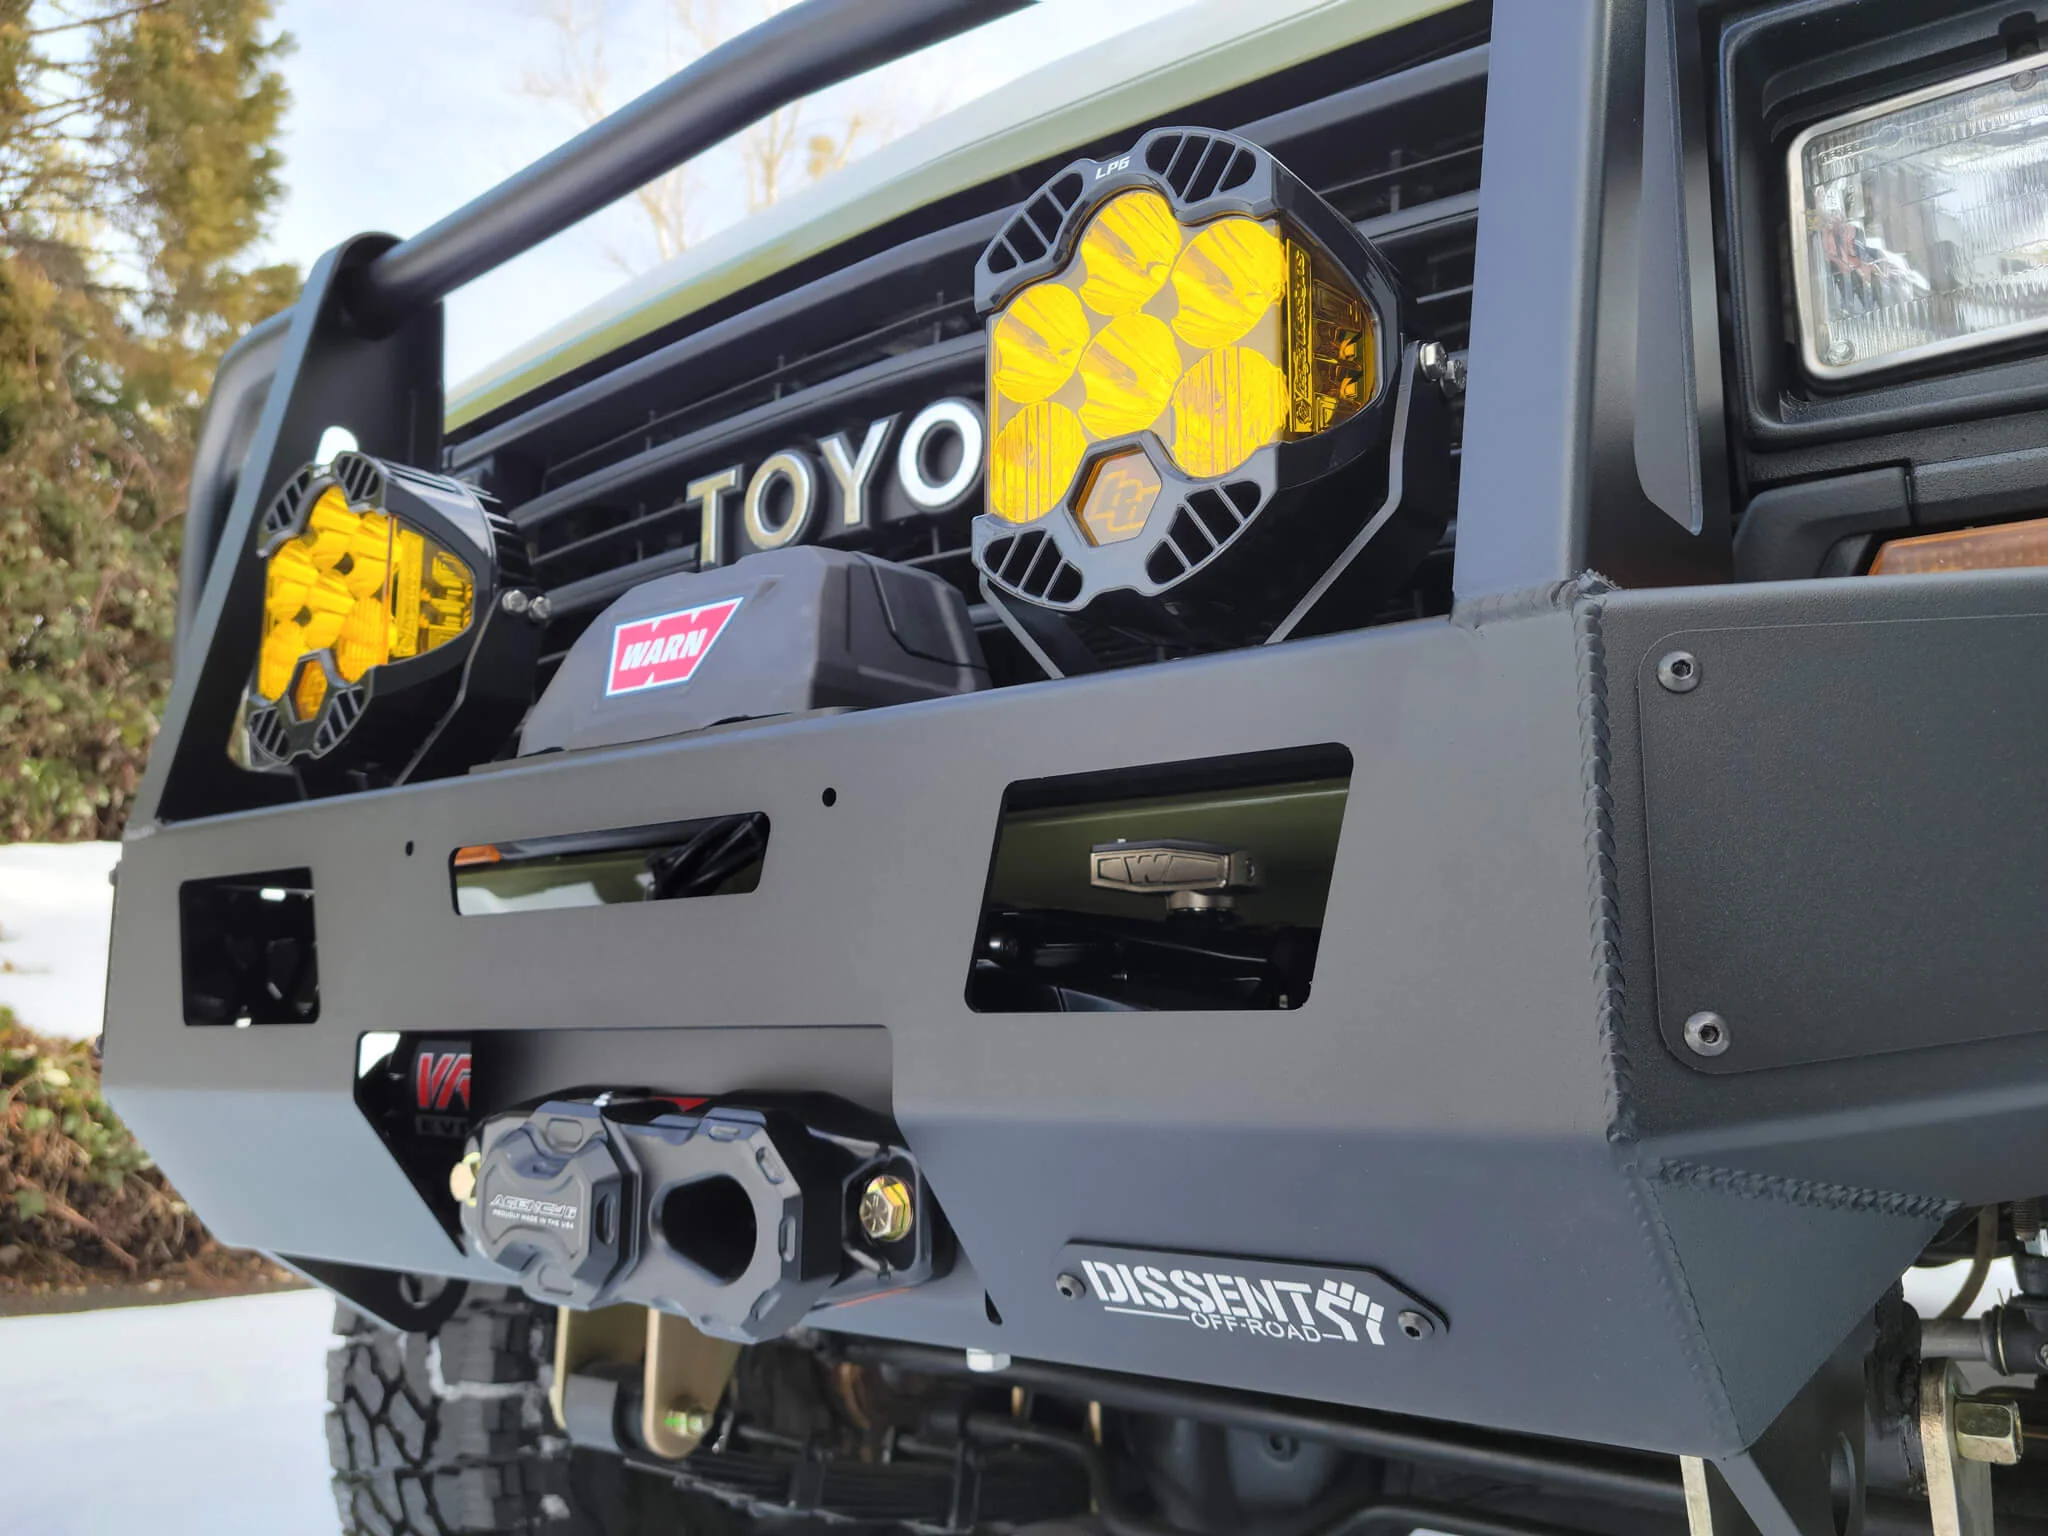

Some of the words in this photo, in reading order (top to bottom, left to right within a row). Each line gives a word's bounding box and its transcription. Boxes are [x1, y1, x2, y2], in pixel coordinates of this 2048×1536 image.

[1095, 155, 1131, 180] LP6
[619, 628, 708, 672] WARN
[1080, 1260, 1313, 1326] DISSENT
[1189, 1310, 1323, 1343] OFF-ROAD
